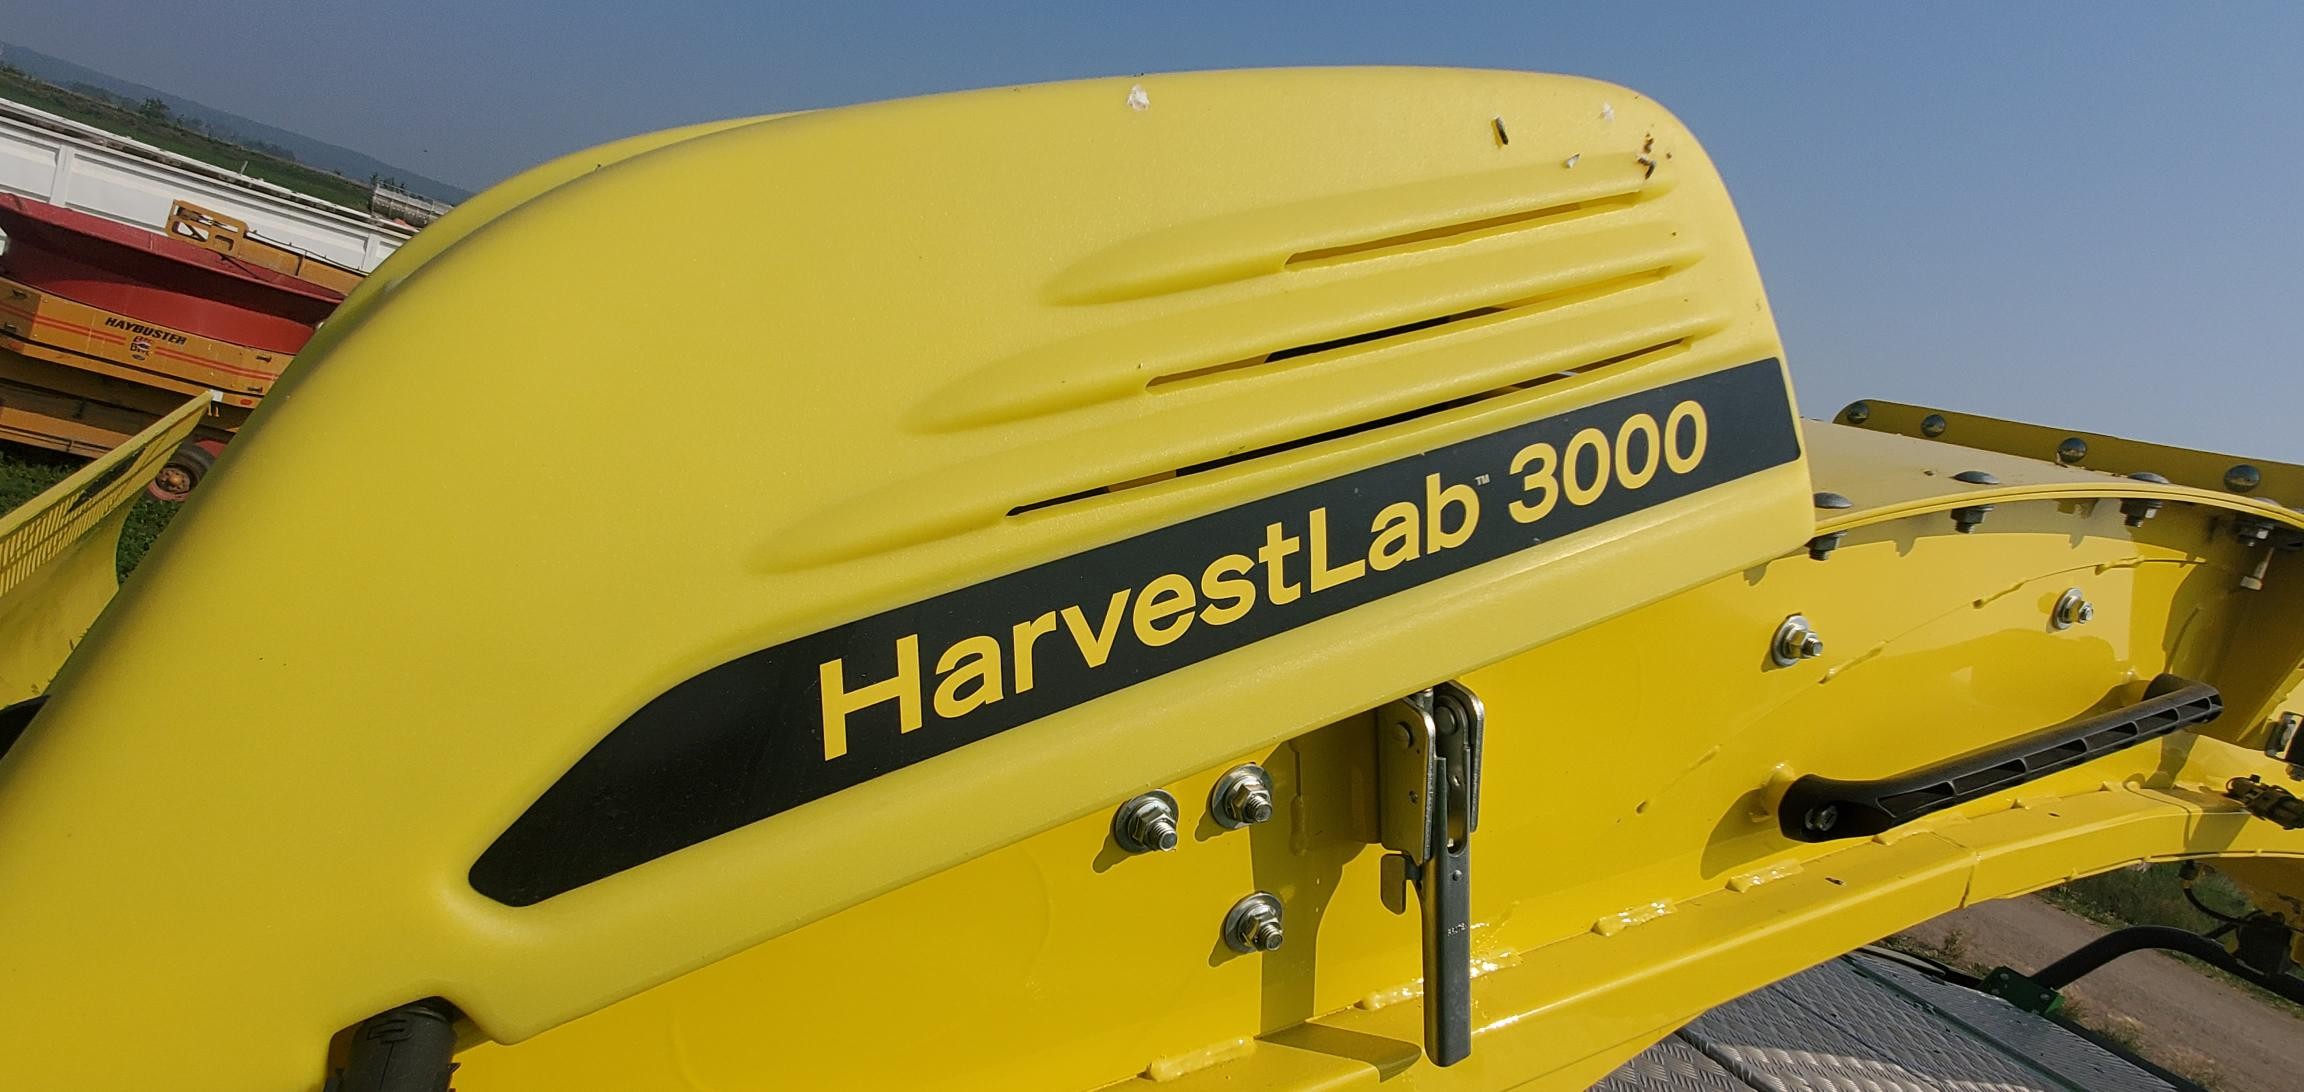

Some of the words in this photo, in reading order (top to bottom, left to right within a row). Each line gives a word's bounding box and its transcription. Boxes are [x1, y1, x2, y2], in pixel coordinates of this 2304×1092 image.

[105, 317, 187, 345] HAYBUSTER
[819, 473, 1480, 761] HarvestLab
[1508, 400, 1708, 524] 3000
